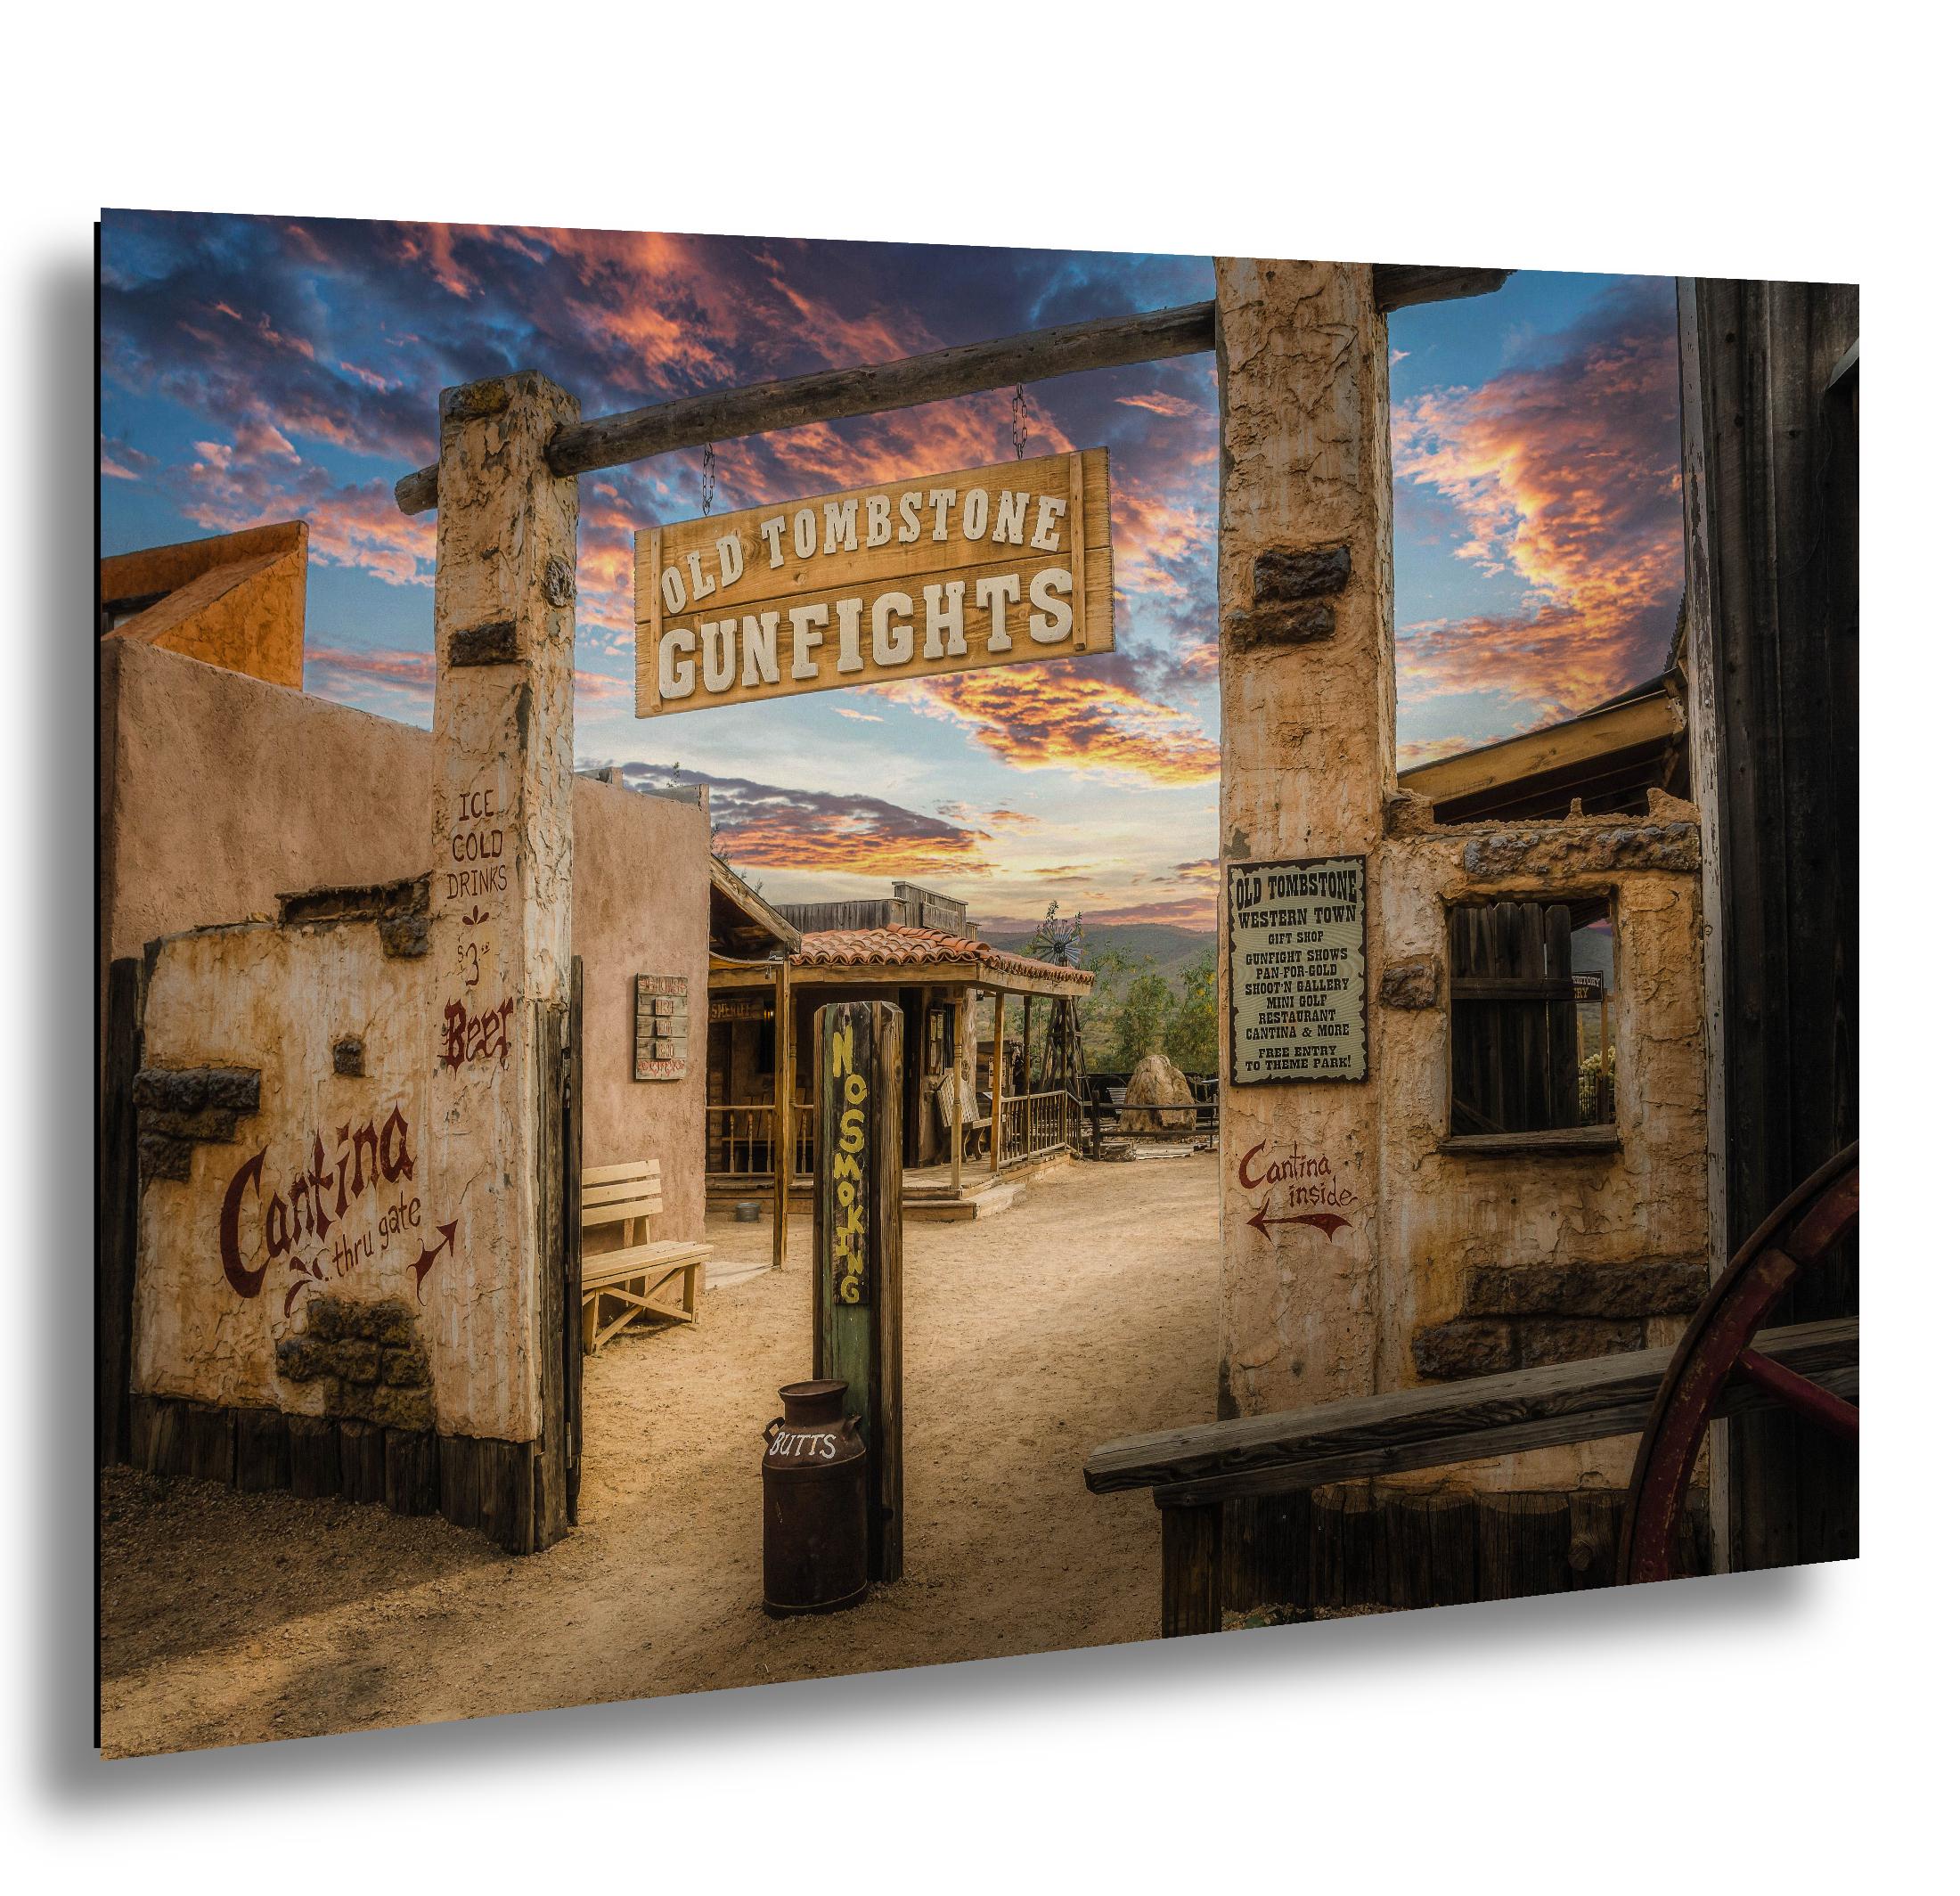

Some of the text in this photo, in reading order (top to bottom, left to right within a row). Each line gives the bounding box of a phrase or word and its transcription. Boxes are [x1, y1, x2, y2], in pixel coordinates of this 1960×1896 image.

[661, 488, 1067, 614] OLD TOMBSTONE
[658, 568, 1073, 699] GUNFIGHTS
[459, 789, 494, 821] ICE
[452, 830, 503, 862] COLD
[446, 864, 508, 900] DRINKS
[1236, 870, 1358, 911] OLD TOMBSTONE
[1237, 904, 1357, 928] WESTERN TOWN
[1268, 930, 1324, 945] GIFT SHOP
[1245, 948, 1348, 965] GUNFIGHT SHOWS
[1256, 964, 1337, 979] PAN-FOR-GOLD
[1245, 978, 1350, 995] SHOOT'N GALLERY
[1266, 994, 1327, 1009] MINI GOLF
[1245, 1024, 1350, 1040] CANTINA & MORE
[1259, 1009, 1336, 1025] RESTAURANT
[444, 997, 514, 1074] Beer
[1259, 1045, 1337, 1058] FREE ENTRY
[1245, 1055, 1352, 1071] TO THEME PARK!
[832, 1024, 870, 1304] NO SMOKING
[1238, 1139, 1332, 1189] Cantina
[220, 1100, 418, 1299] Cantina
[1289, 1175, 1359, 1208] inside
[331, 1190, 421, 1278] thru gate
[769, 1431, 837, 1459] BUTTS
